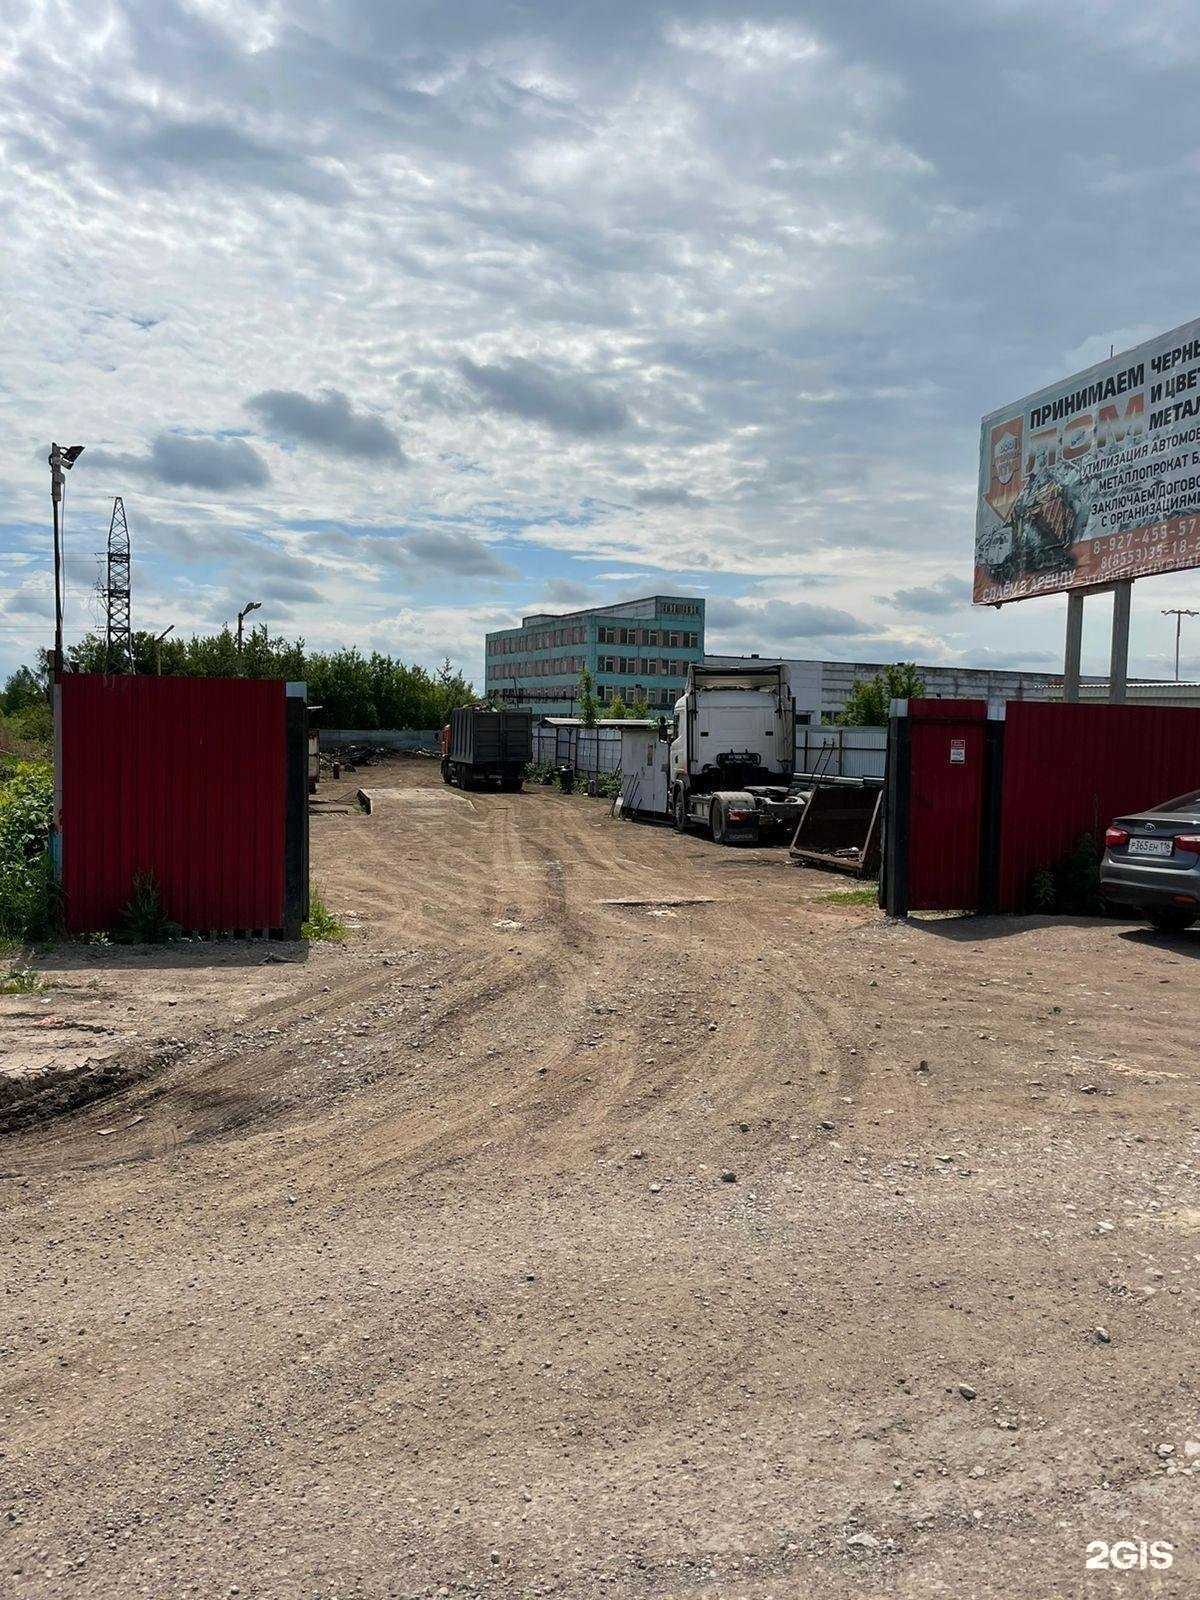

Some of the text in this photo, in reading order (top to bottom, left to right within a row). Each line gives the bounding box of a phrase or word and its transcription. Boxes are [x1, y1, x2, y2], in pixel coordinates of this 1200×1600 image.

[1030, 363, 1144, 429] ПРИНИМАЕМ
[1151, 382, 1162, 403] И
[1081, 445, 1148, 478] УТИЛИЗАЦИЯ
[1099, 454, 1189, 492] МЕТАЛЛОПРОКАТ
[1091, 487, 1155, 515] ЗАКЛЮЧАЕМ
[1094, 518, 1200, 554] 8-927-459-57
[1101, 515, 1108, 528] С
